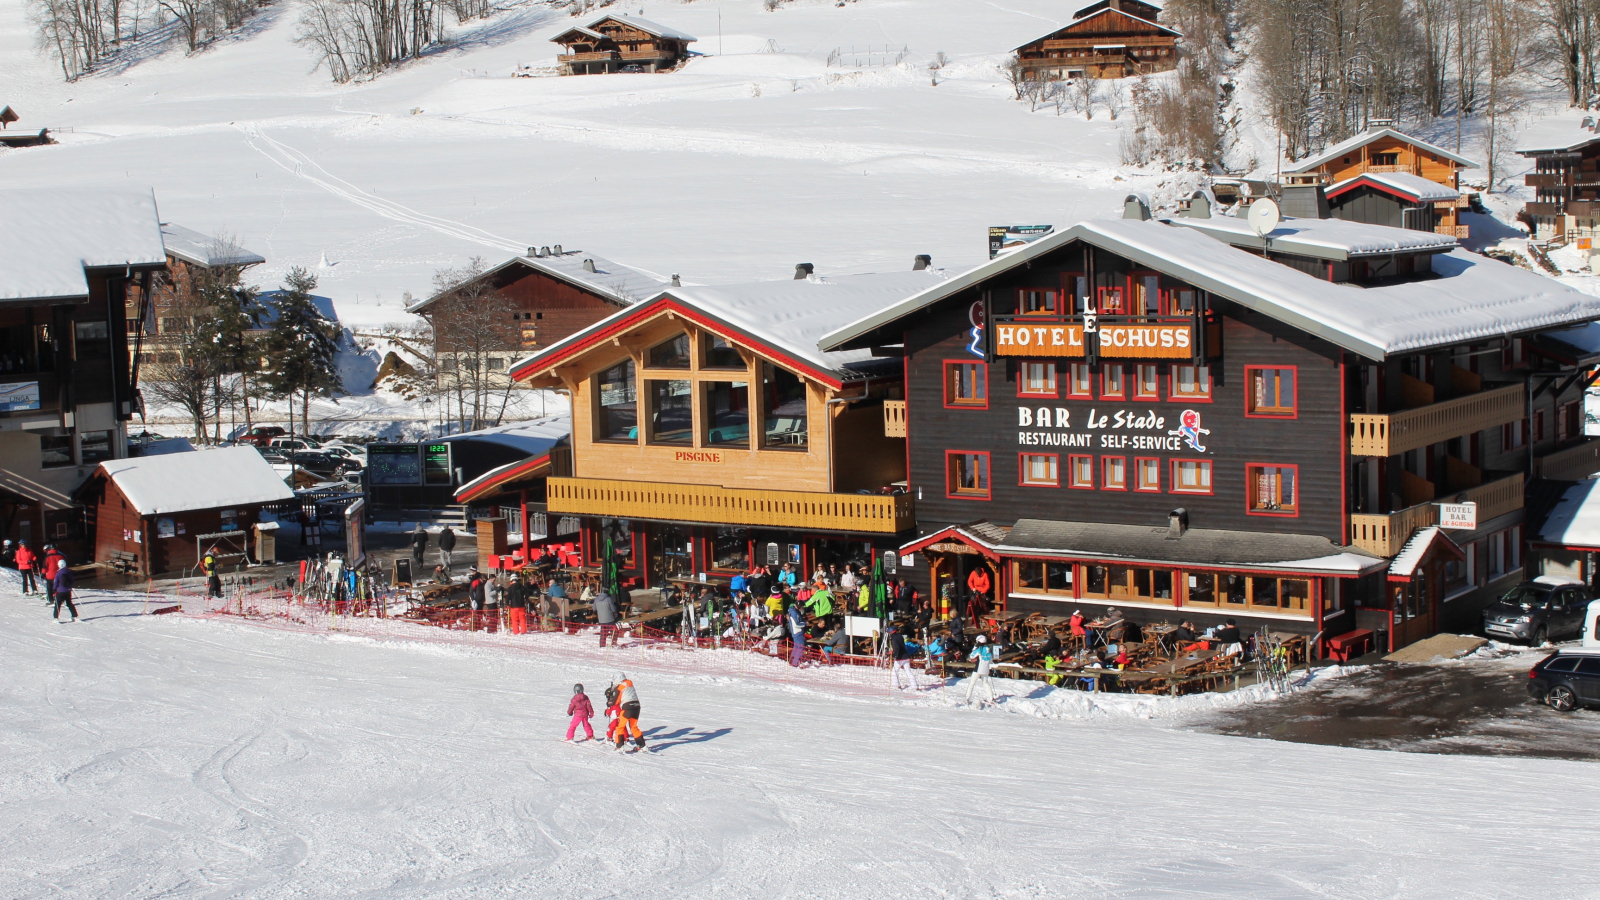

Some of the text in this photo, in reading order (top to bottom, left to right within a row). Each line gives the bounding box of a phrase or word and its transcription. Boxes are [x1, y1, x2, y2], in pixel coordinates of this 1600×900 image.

[999, 296, 1190, 347] HOTEL LE SCHUSS
[1018, 406, 1165, 430] BAR Le Stade
[1018, 431, 1181, 451] RESTAURANT SELF-SERVICE
